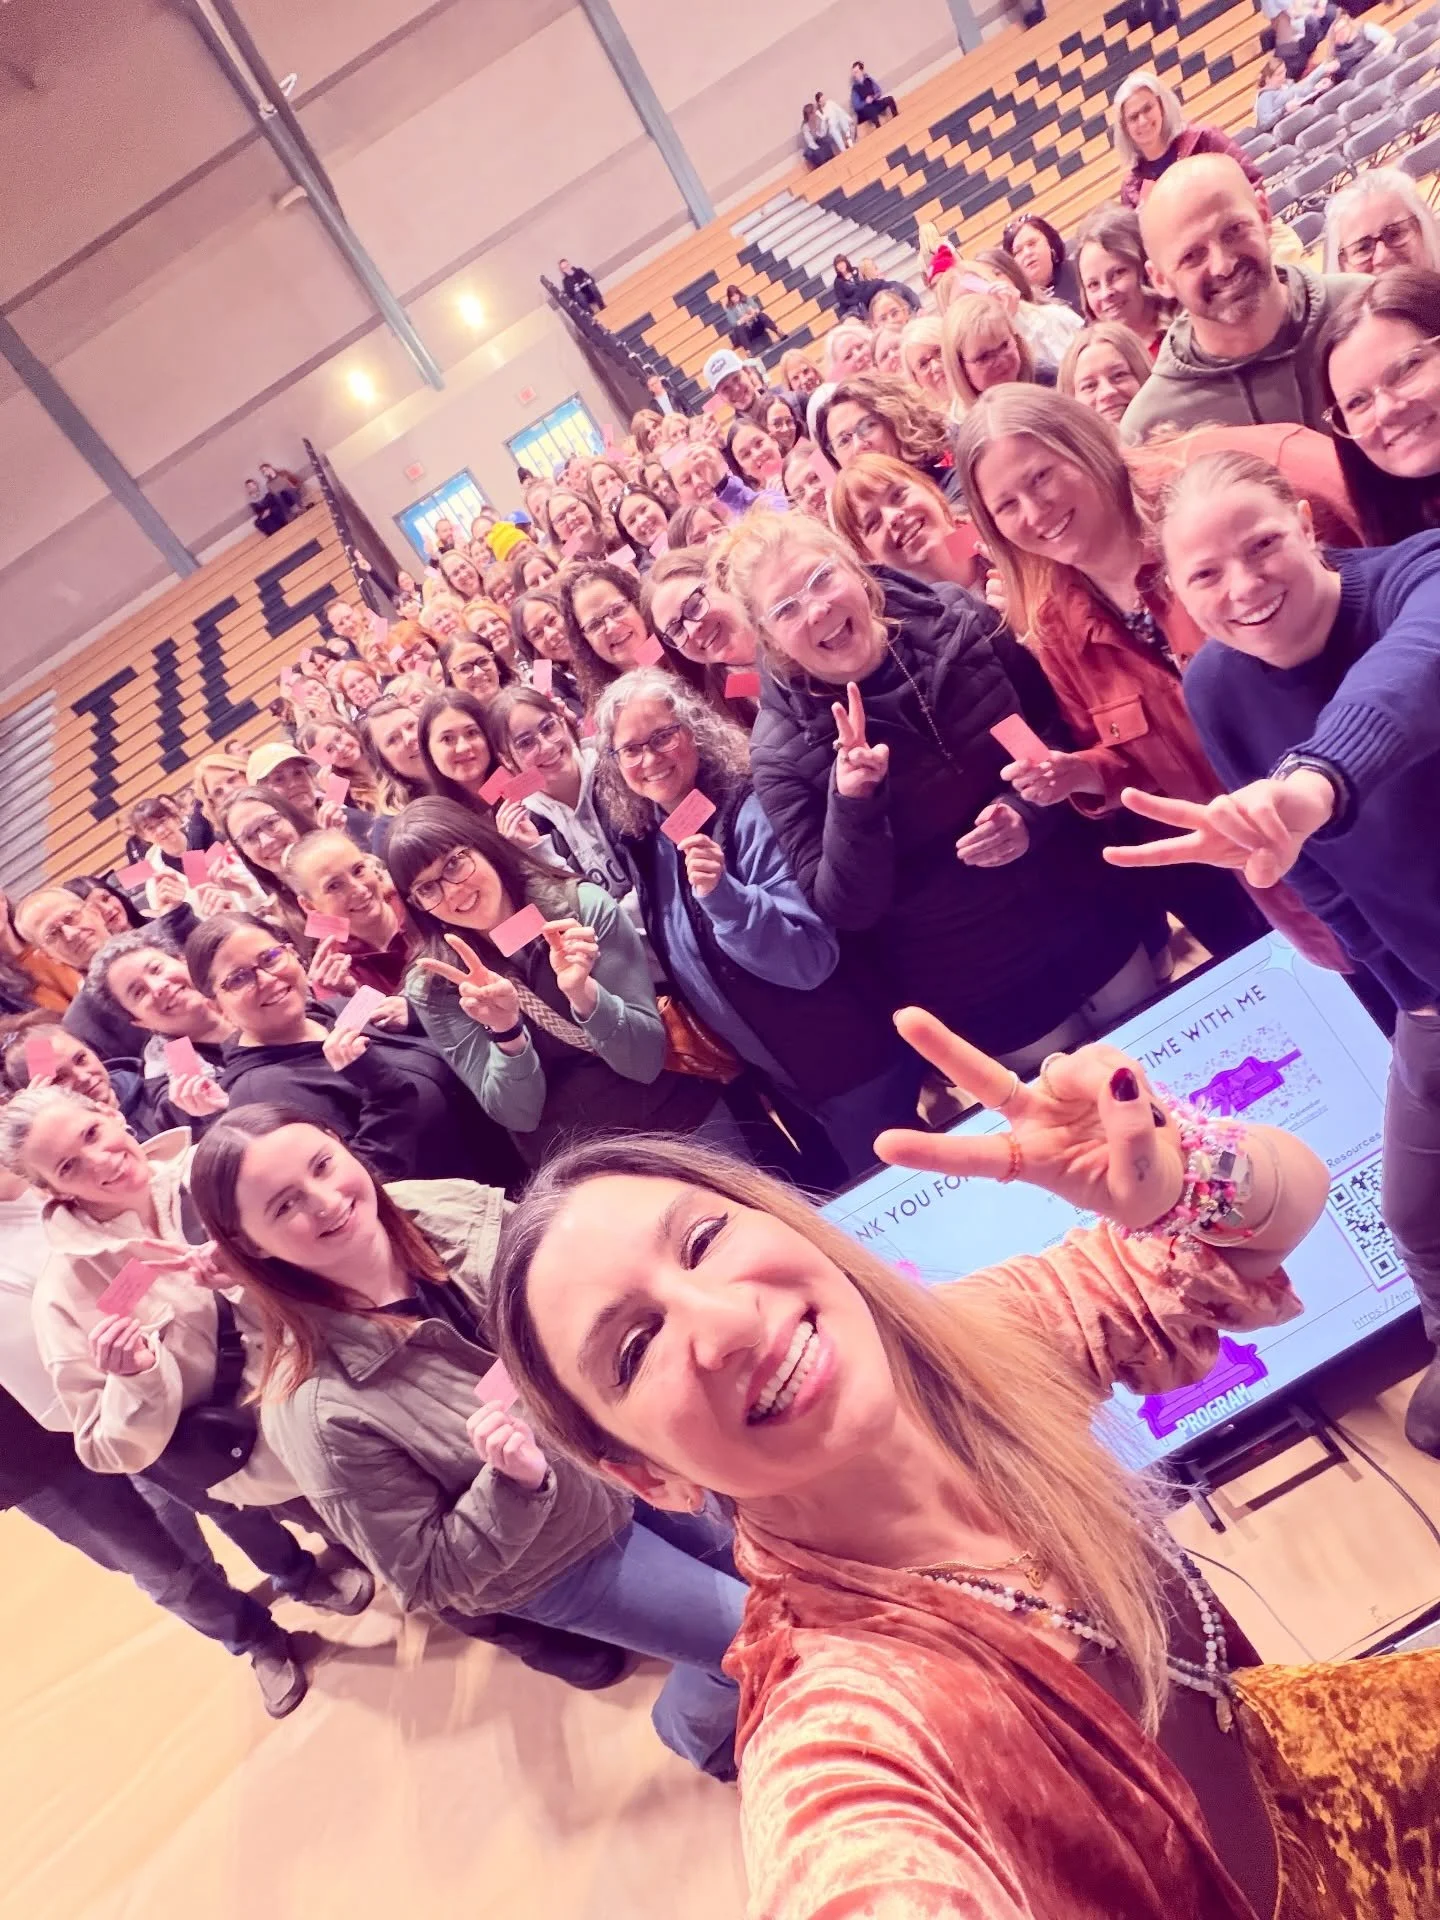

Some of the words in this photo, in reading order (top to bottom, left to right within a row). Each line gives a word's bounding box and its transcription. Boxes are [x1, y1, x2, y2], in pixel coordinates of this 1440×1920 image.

[884, 1189, 931, 1225] YOU
[932, 1175, 976, 1198] FO
[1136, 1036, 1182, 1069] IME
[1181, 1003, 1234, 1042] WITH
[1234, 984, 1267, 1012] ME
[1326, 1131, 1383, 1168] Resources
[1175, 1382, 1252, 1437] PROGRAM
